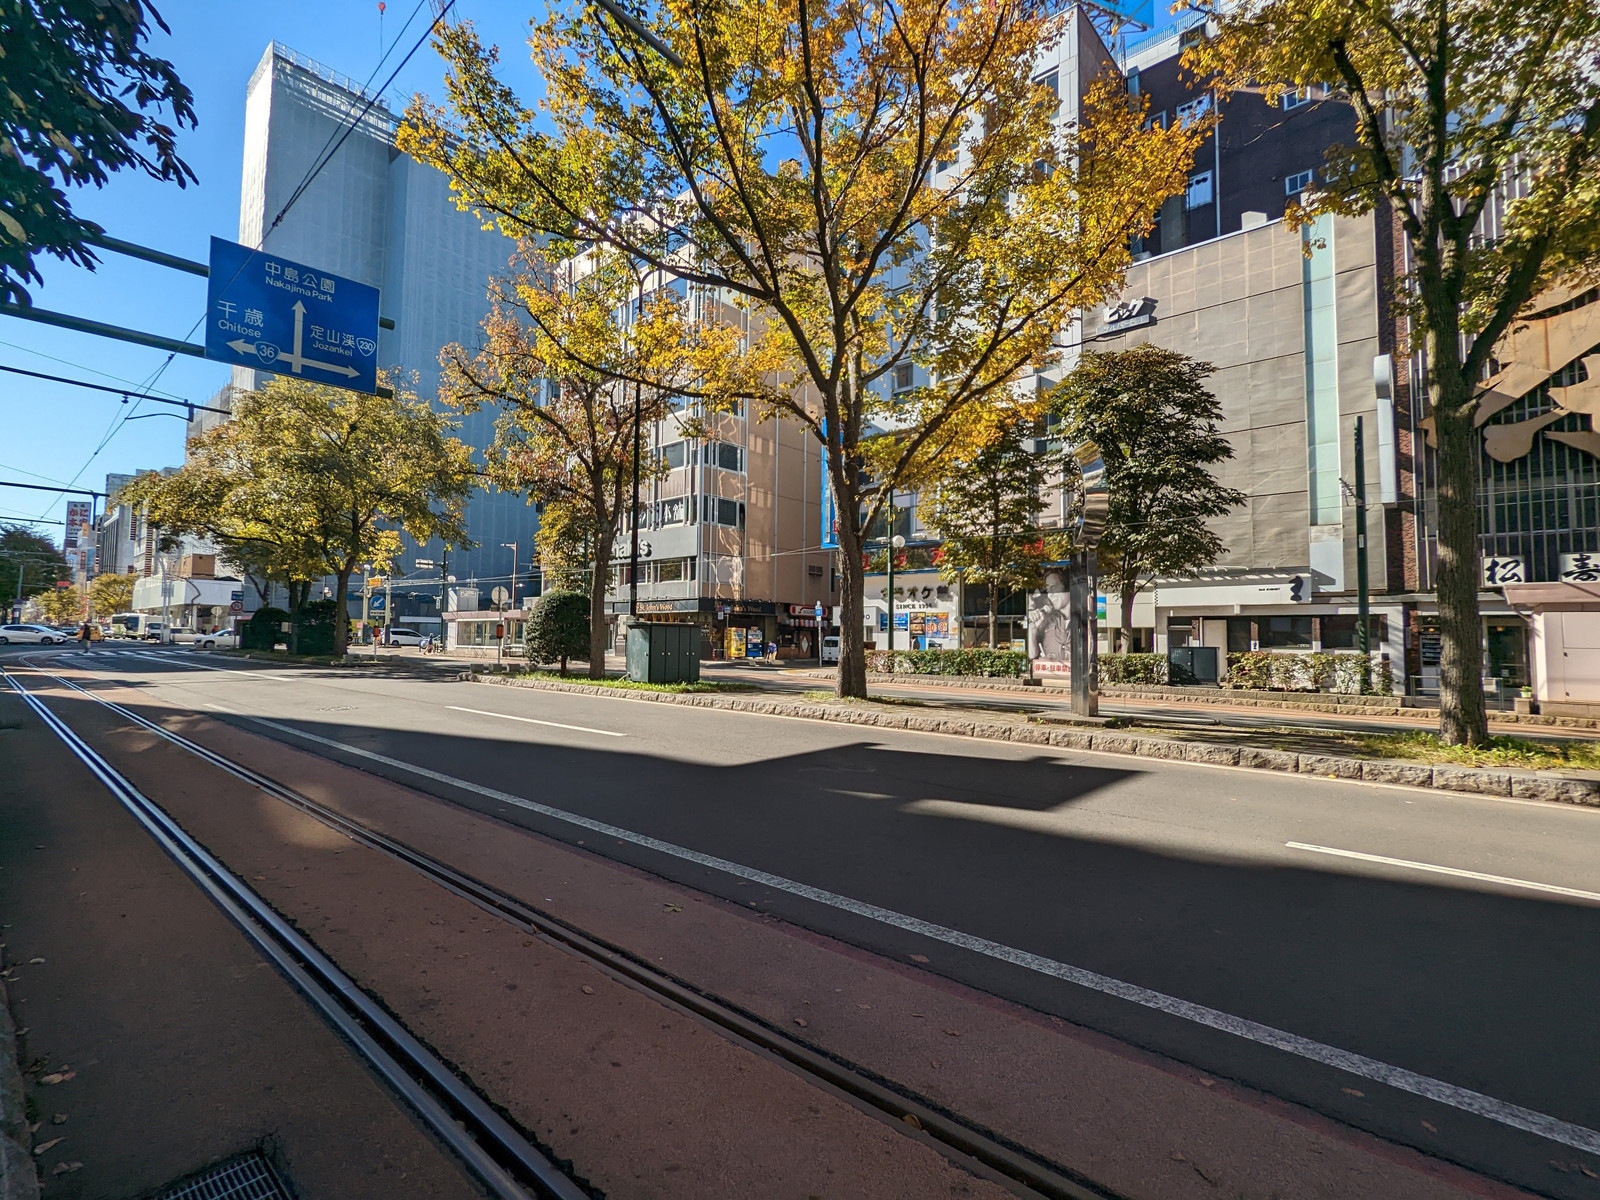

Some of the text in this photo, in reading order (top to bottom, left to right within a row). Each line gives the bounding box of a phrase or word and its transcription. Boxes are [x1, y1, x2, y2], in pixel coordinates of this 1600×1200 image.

[265, 261, 335, 294] 中島公園
[265, 277, 333, 303] Nakajima Park
[217, 300, 264, 328] 千歳
[218, 319, 262, 338] Chitose
[310, 325, 356, 349] 定山渓
[259, 345, 275, 358] 36
[312, 340, 353, 357] Jozankei
[359, 340, 373, 351] 230
